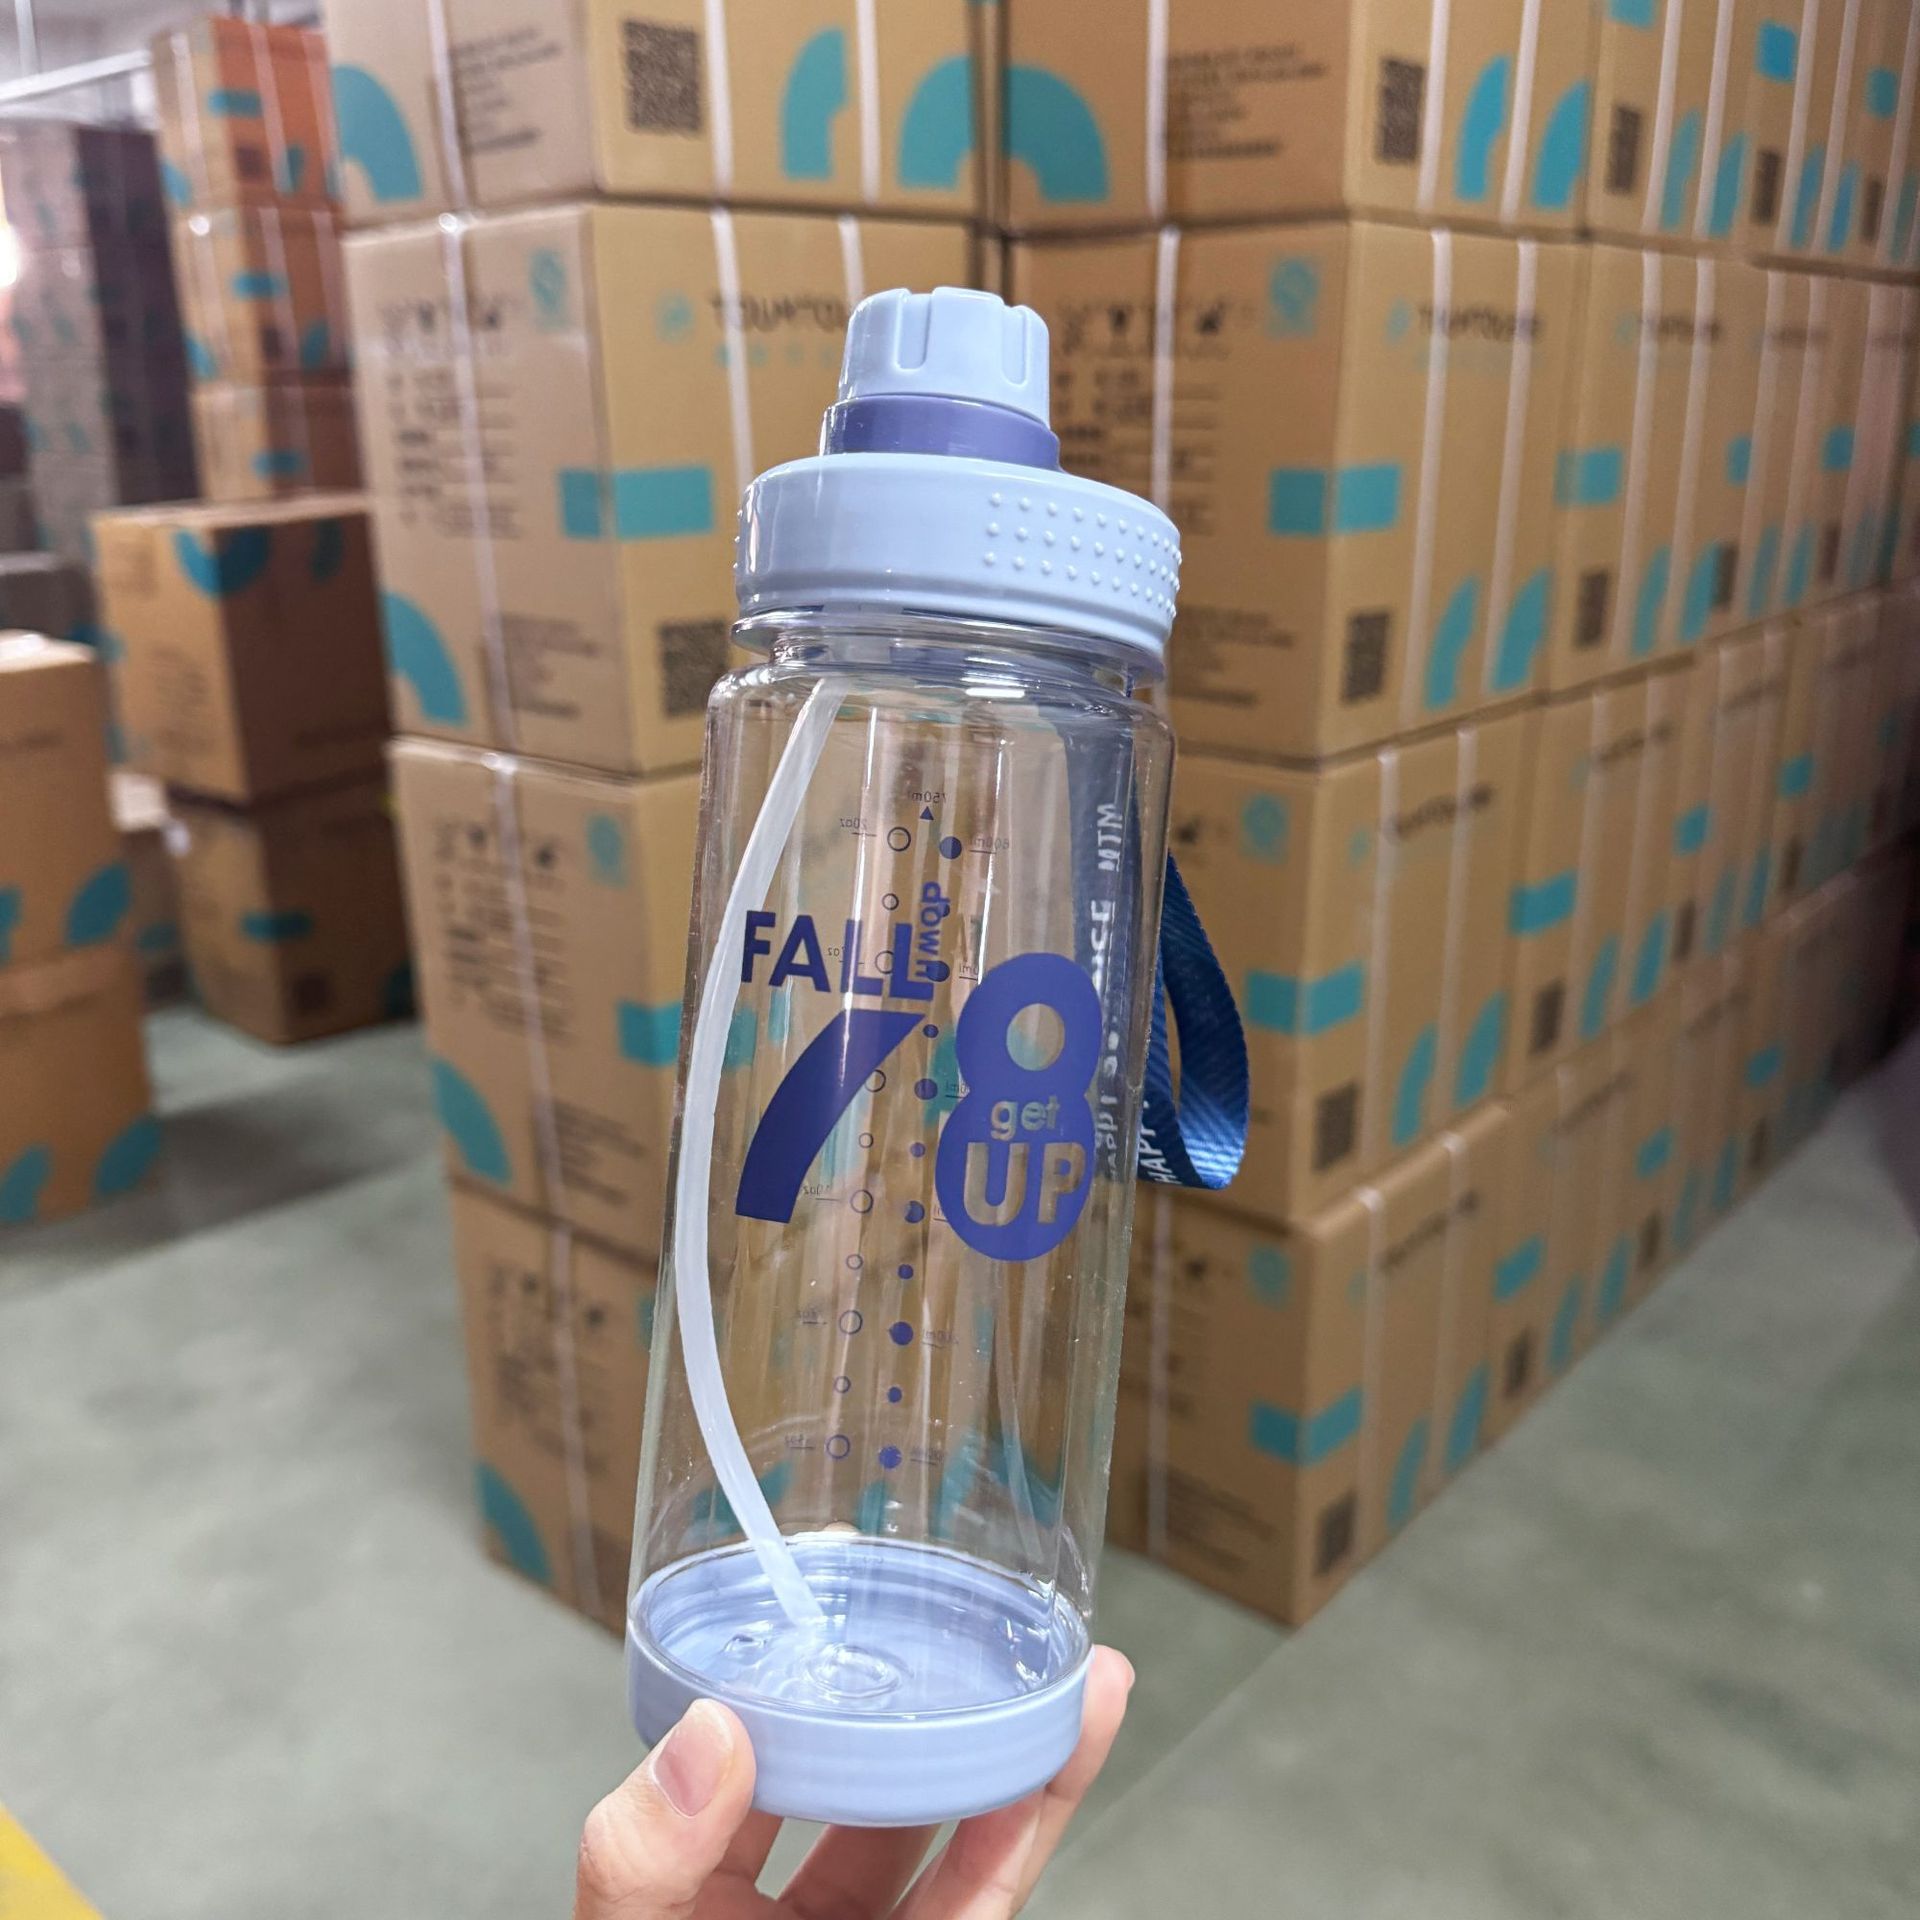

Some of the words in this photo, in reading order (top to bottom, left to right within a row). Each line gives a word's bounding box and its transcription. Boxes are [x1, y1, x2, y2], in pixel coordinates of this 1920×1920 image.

[741, 910, 935, 1002] FALL
[916, 881, 950, 978] down
[991, 1096, 1060, 1142] get
[963, 1142, 1086, 1226] UP
